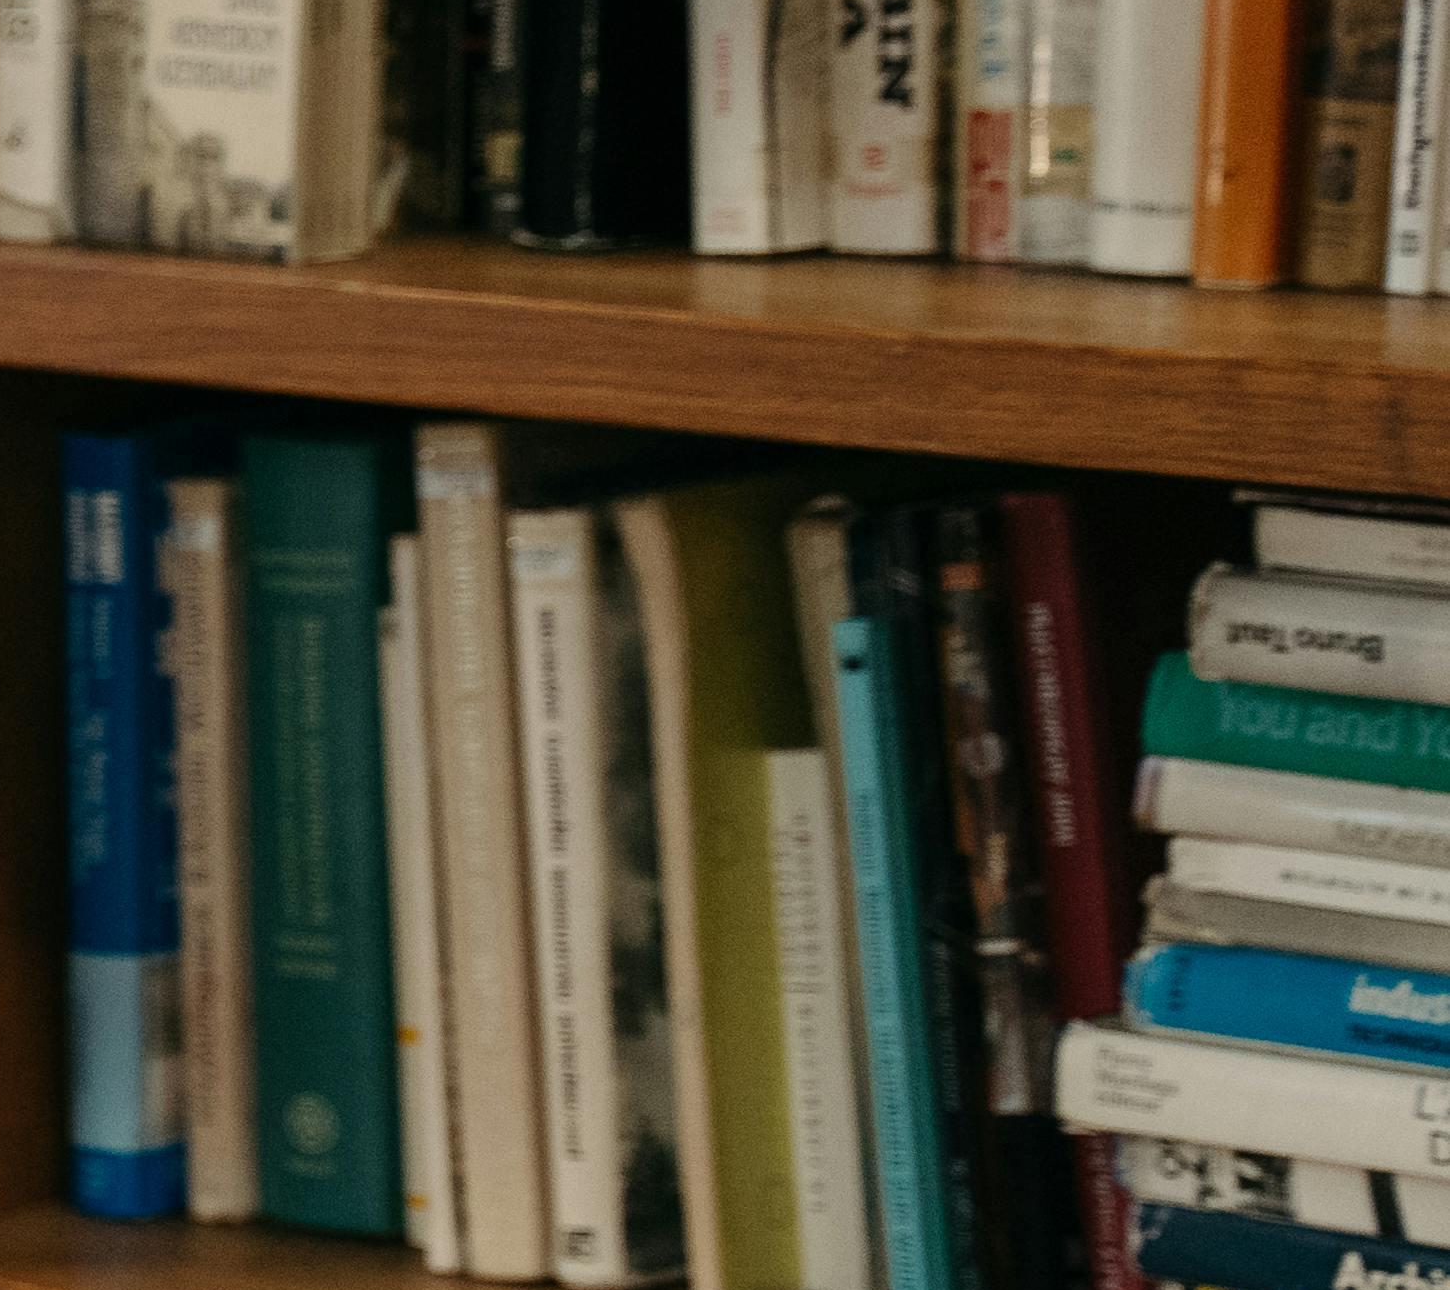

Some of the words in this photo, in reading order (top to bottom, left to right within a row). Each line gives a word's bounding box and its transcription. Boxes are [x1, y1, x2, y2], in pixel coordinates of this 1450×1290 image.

[1224, 618, 1289, 656] Taut
[1293, 625, 1387, 665] Bruno
[1305, 698, 1401, 752] and
